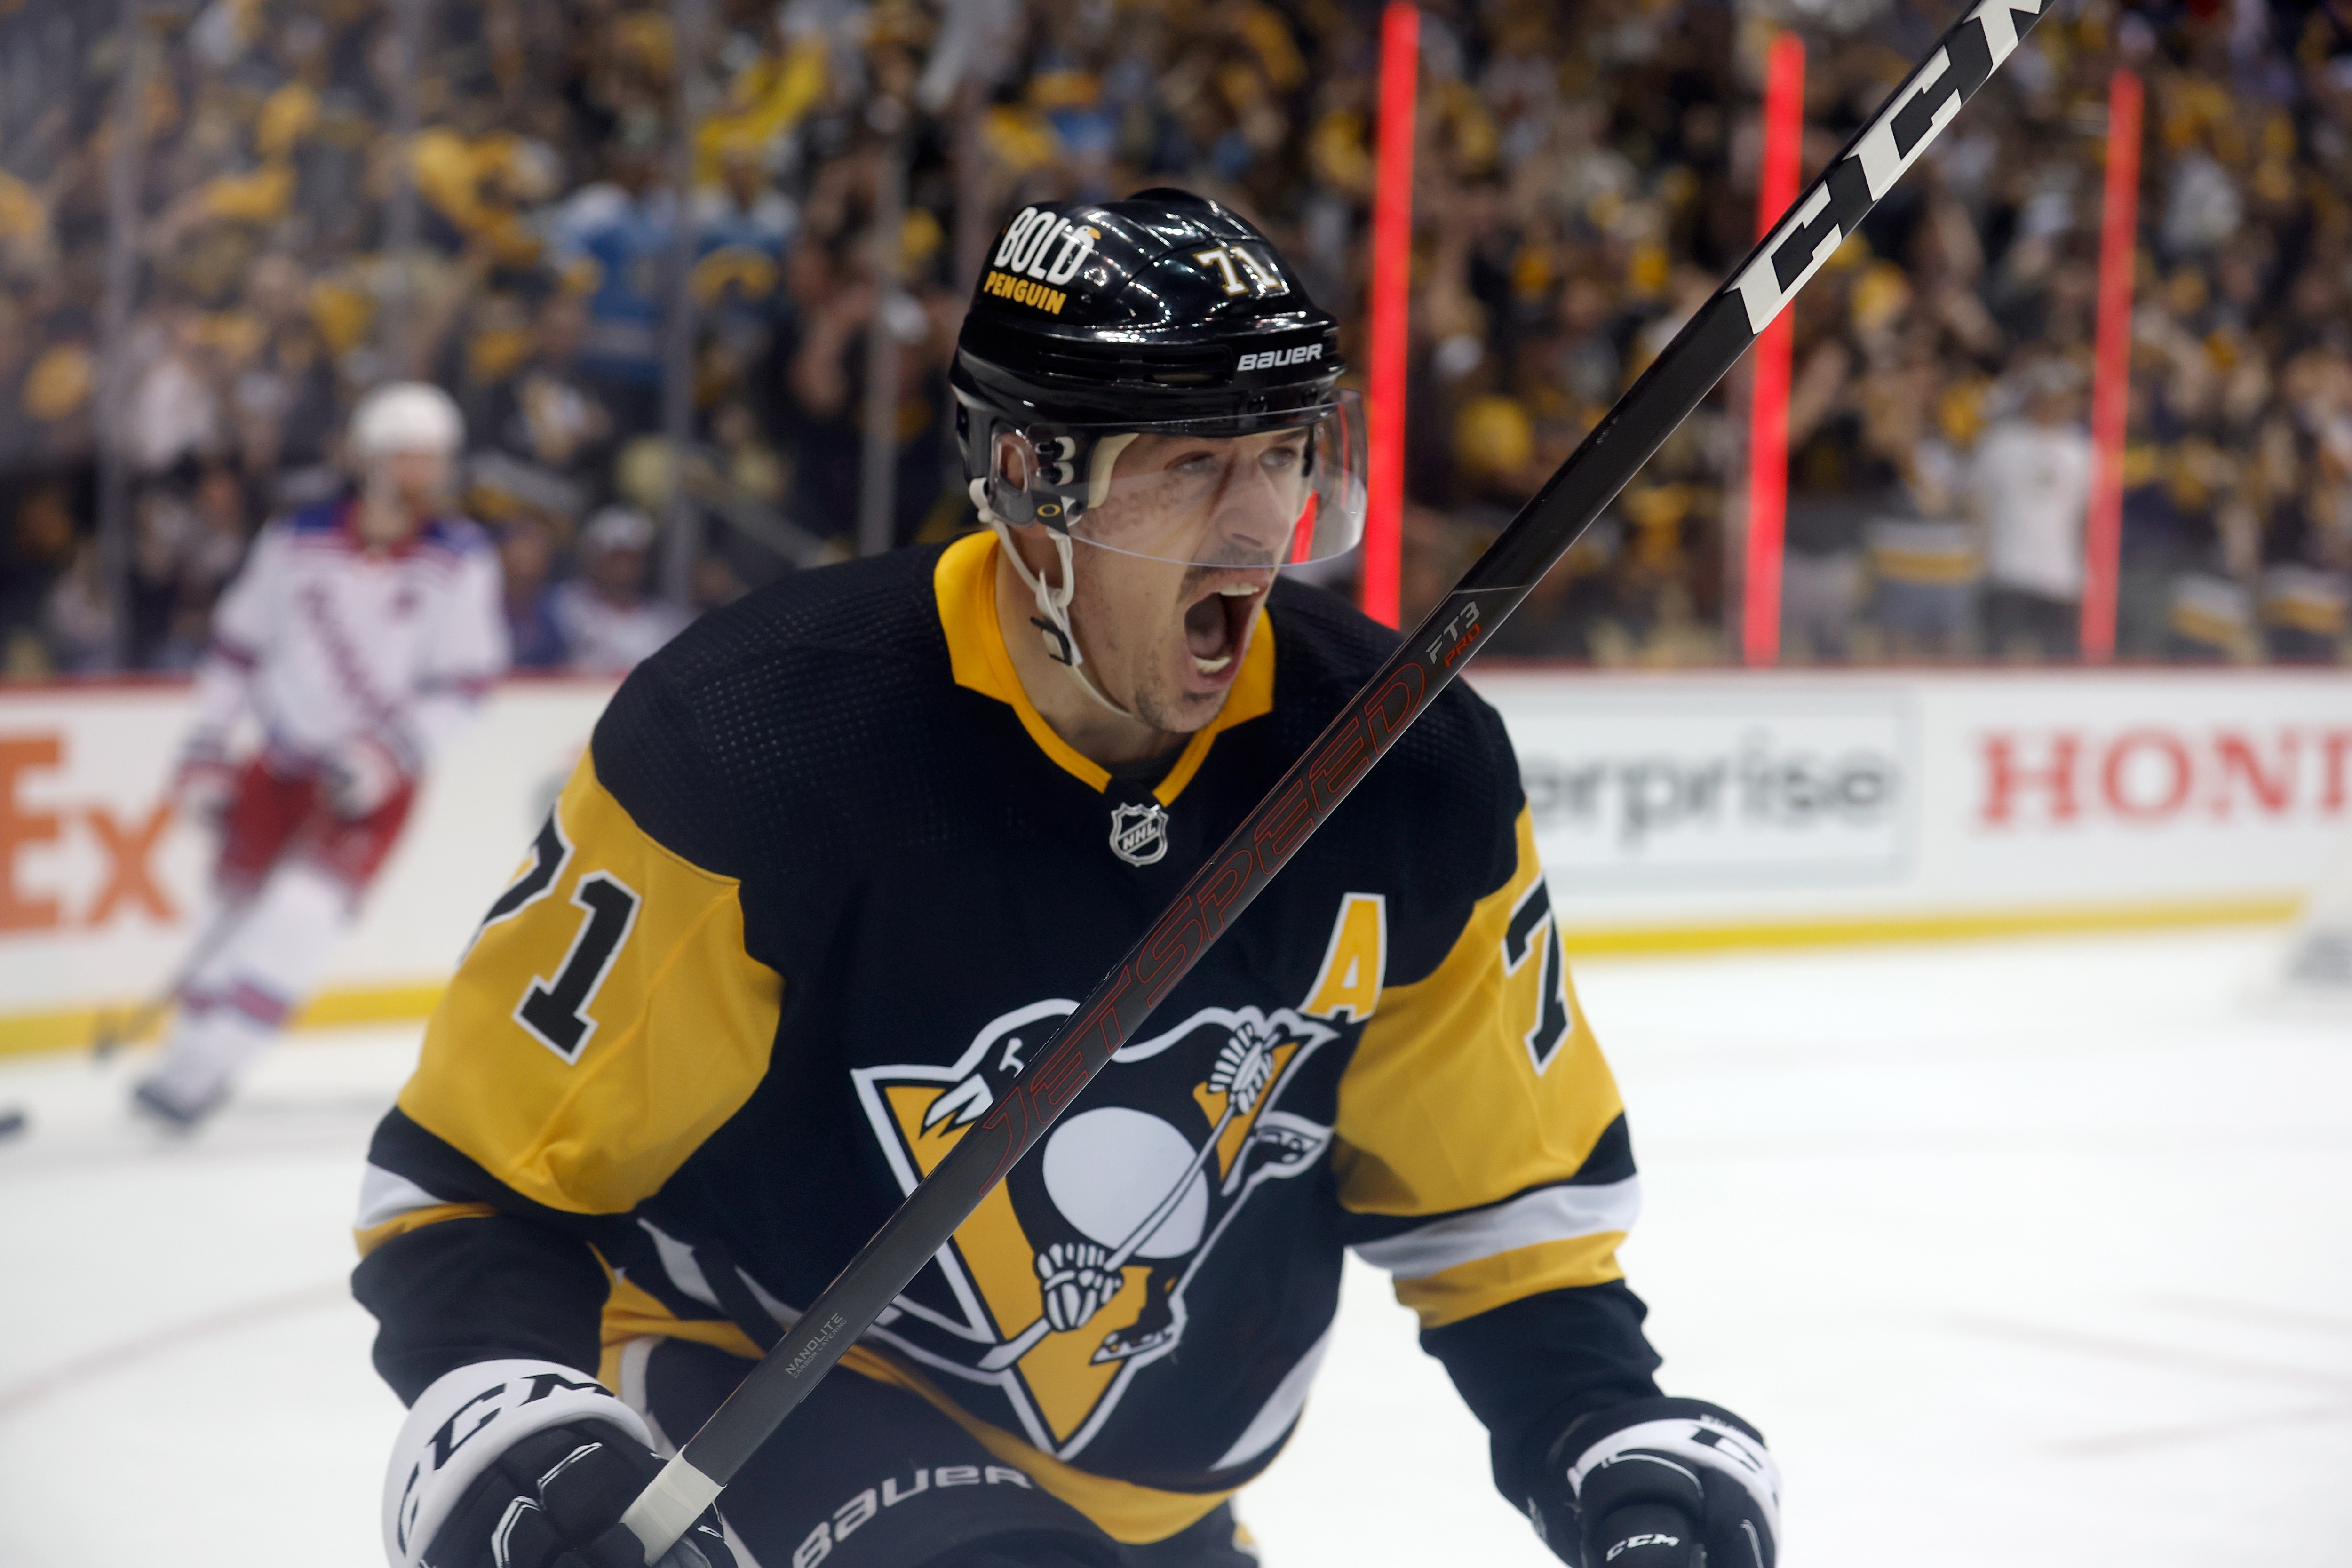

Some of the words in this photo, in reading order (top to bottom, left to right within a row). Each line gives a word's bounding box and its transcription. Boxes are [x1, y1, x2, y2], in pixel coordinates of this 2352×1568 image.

[993, 206, 1102, 286] BOLD
[1192, 245, 1282, 296] 71
[983, 270, 1067, 316] PENGUIN
[1425, 600, 1480, 665] FT3
[1444, 622, 1482, 668] PRO
[1122, 823, 1157, 851] NHL
[978, 662, 1425, 1198] JETSPEED
[1298, 892, 1387, 1025] A
[785, 1313, 843, 1375] NANOLITE
[1606, 1533, 1680, 1562] CCM
